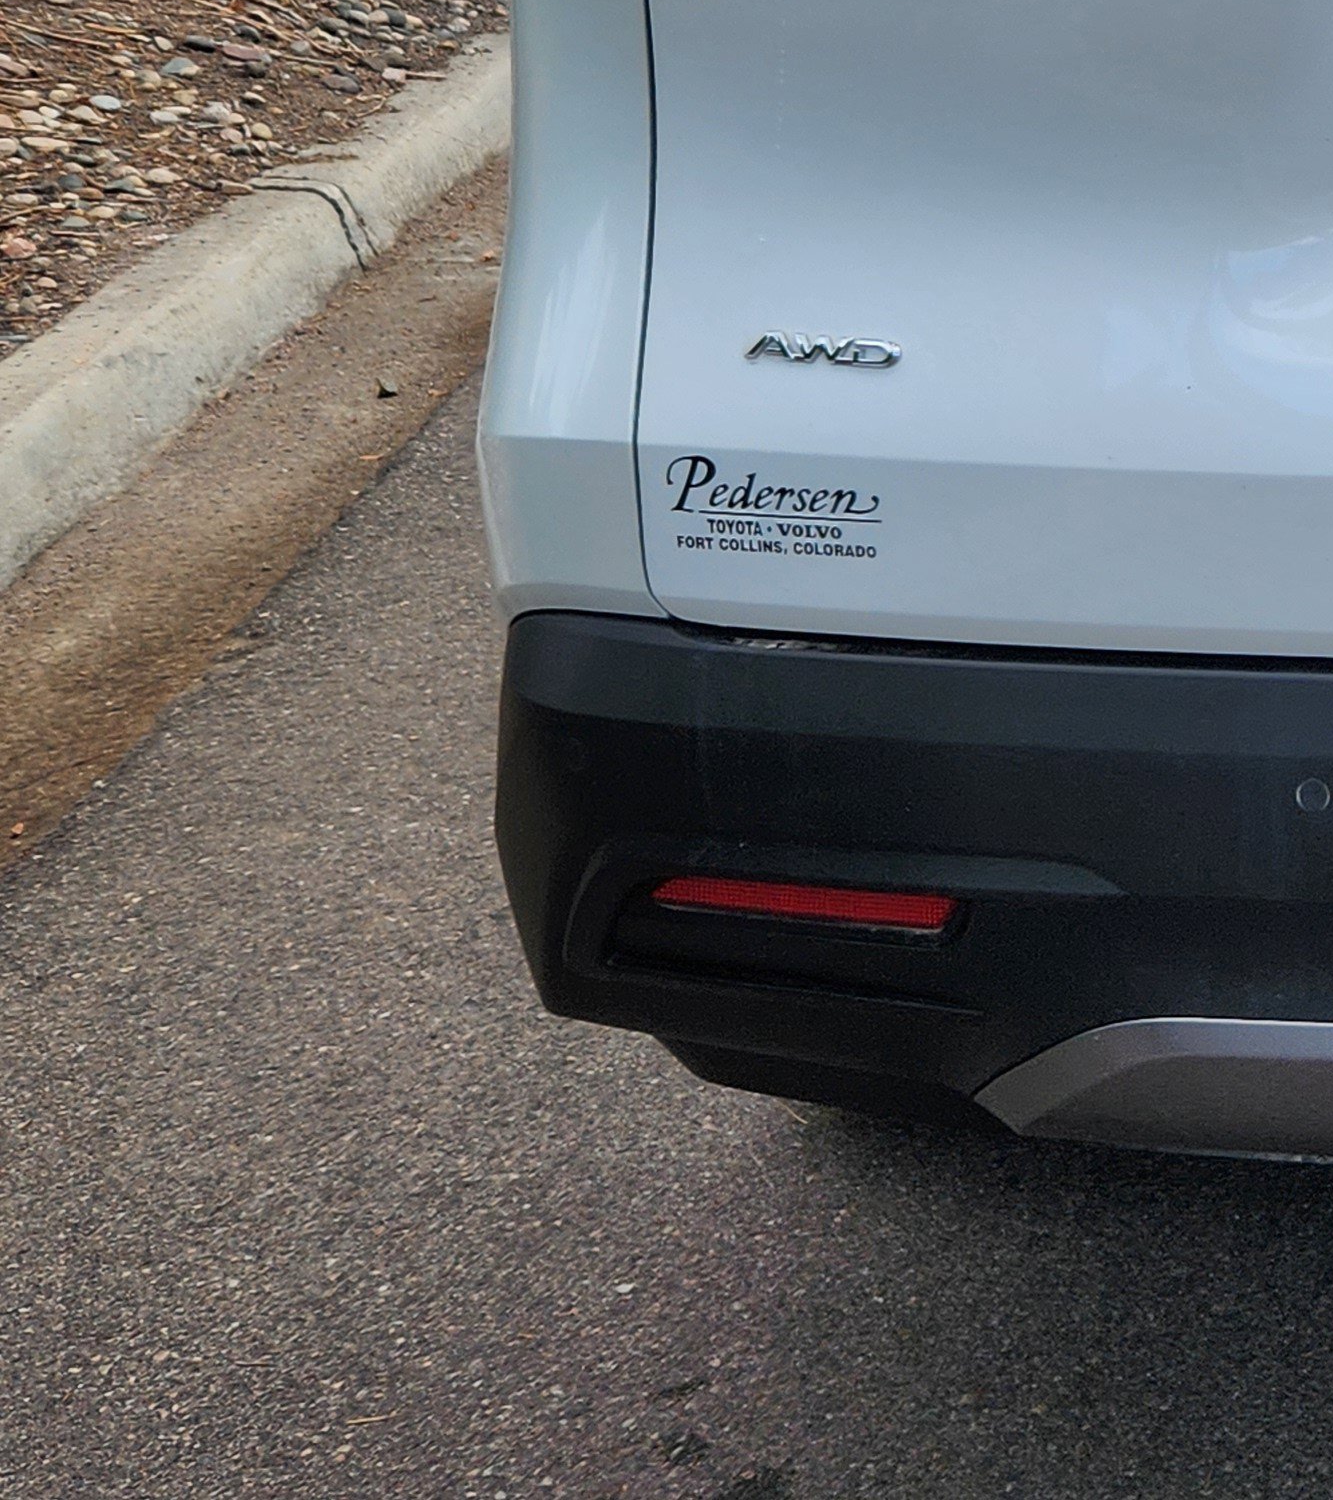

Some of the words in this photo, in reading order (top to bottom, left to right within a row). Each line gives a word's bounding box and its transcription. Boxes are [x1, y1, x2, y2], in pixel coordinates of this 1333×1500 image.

[744, 330, 902, 369] AWD
[666, 454, 881, 516] Pedersen
[706, 518, 764, 536] TOYOTA
[775, 522, 843, 540] VOLVO
[676, 535, 714, 551] FORT
[718, 537, 789, 556] COLLINS,
[792, 541, 878, 559] COLORADO
